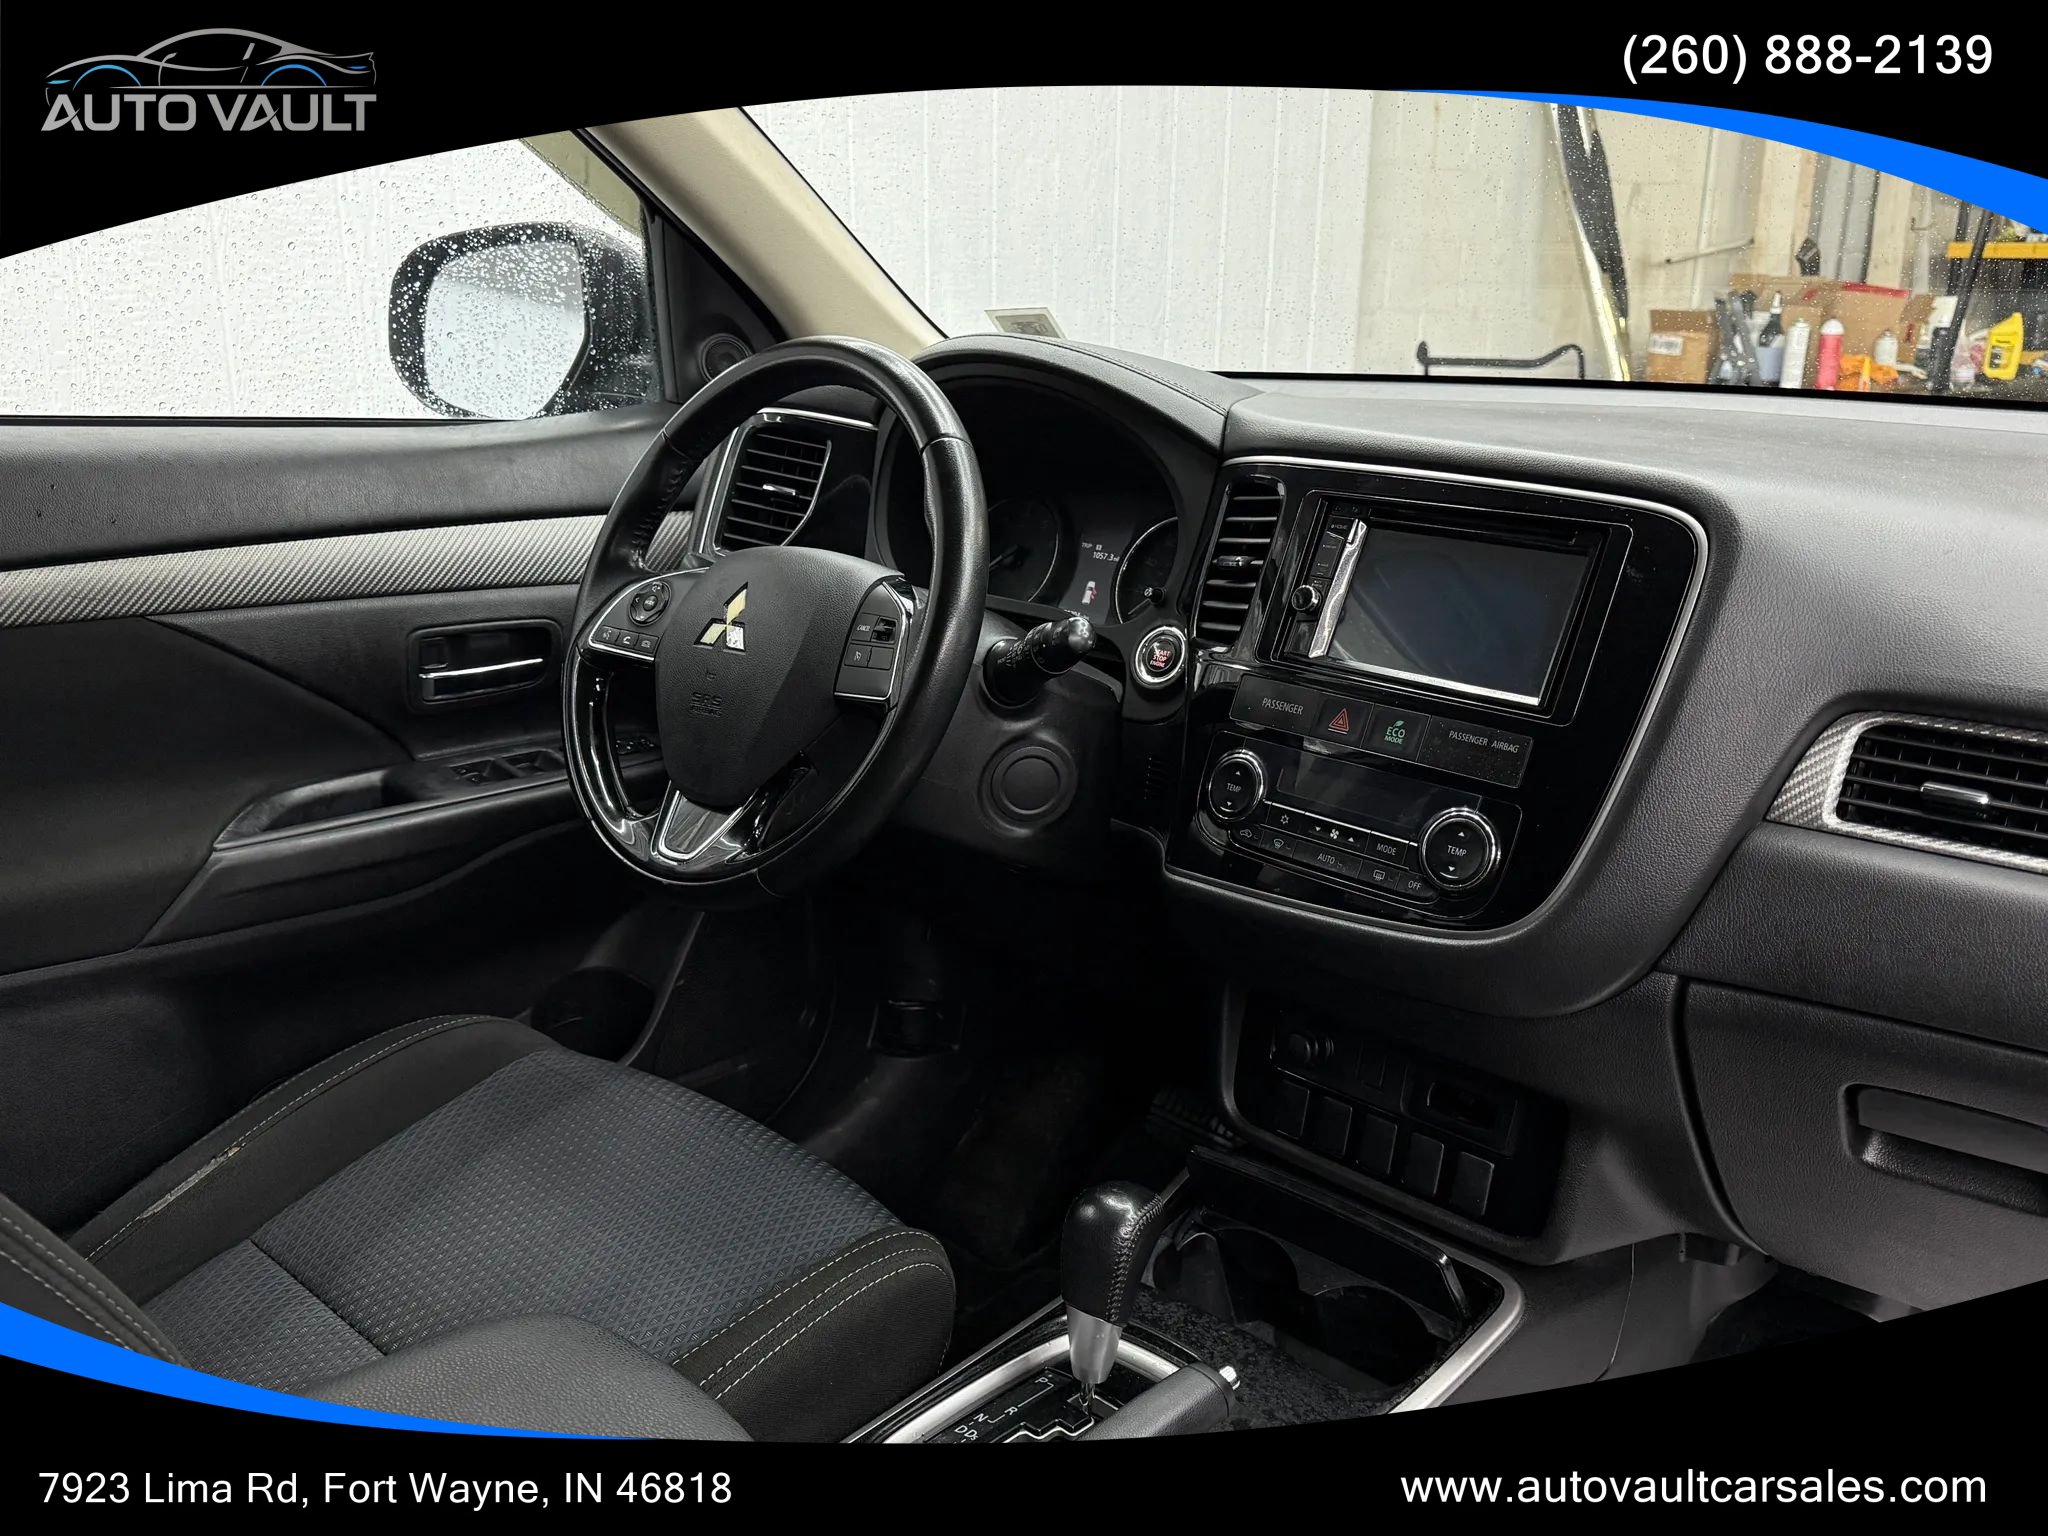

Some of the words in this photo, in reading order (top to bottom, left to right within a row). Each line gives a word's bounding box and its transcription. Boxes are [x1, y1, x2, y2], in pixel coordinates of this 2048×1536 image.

[1262, 697, 1304, 716] PASSENGER
[1386, 726, 1406, 739] ECO
[1384, 735, 1403, 745] MODE
[1448, 729, 1489, 747] PASSENGER
[1491, 740, 1520, 754] AIRBAG
[1226, 783, 1242, 793] TEMP
[1376, 843, 1397, 856] MODE
[1447, 845, 1468, 858] TEMP
[1317, 852, 1336, 865] AUTO
[1407, 880, 1422, 890] OFF
[1004, 1406, 1018, 1415] R
